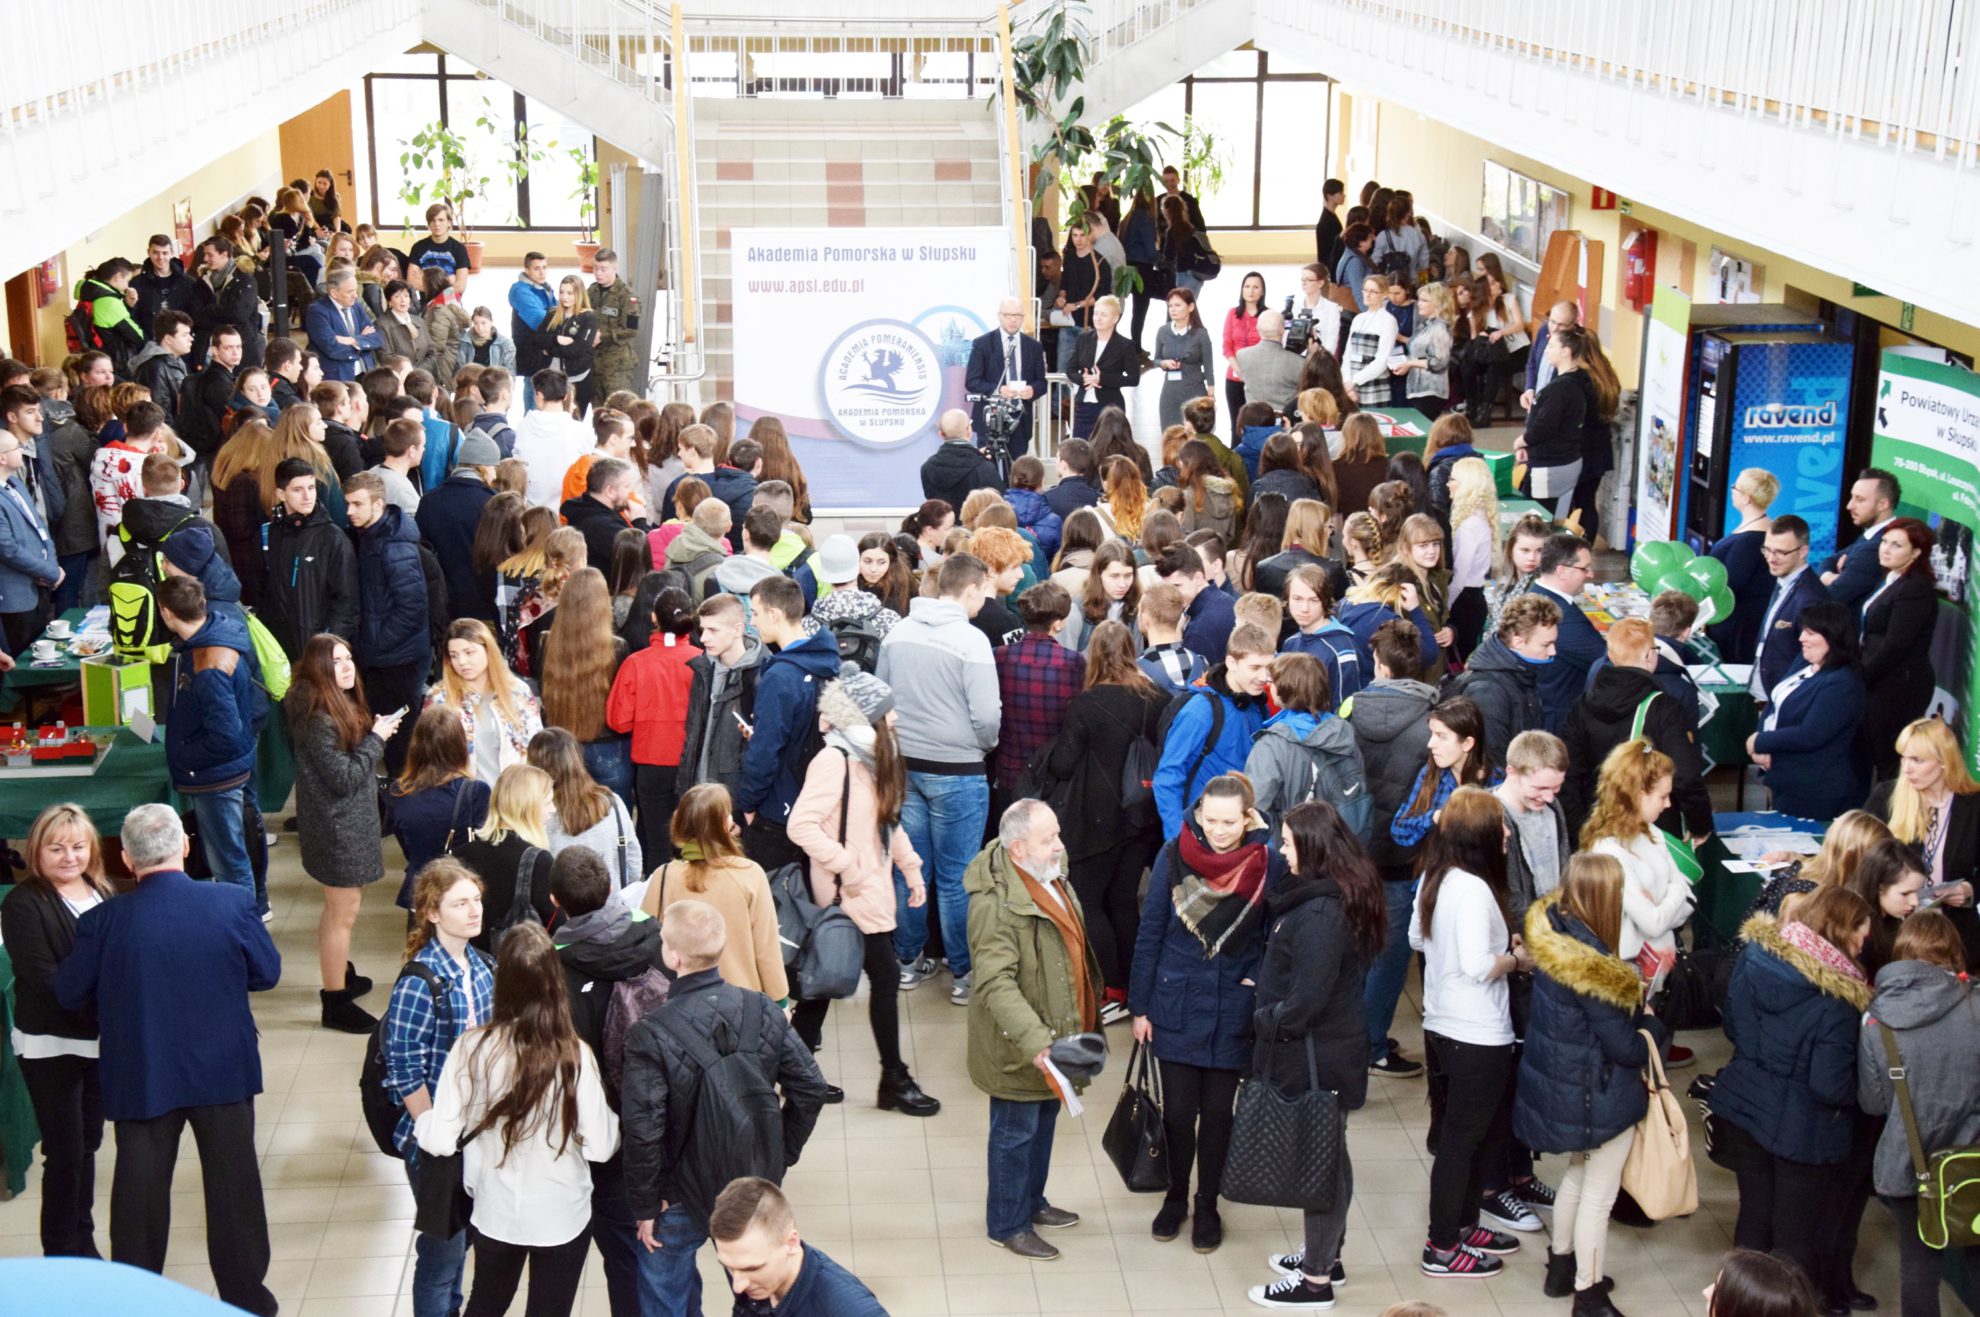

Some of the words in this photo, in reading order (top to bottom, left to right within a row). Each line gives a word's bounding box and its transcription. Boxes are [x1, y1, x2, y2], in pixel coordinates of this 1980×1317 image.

[748, 247, 818, 262] Akademia
[824, 247, 897, 262] Pomorska
[902, 248, 914, 261] w
[919, 246, 977, 262] Słupsku
[748, 279, 865, 293] www.apsl.edu.pl
[838, 338, 869, 380] ACADEMIA
[871, 334, 927, 380] POMERANIENSIS
[838, 408, 879, 417] AKADEMIA
[881, 407, 926, 416] POMORSKA
[1746, 400, 1836, 427] ravend
[1901, 390, 1960, 423] Powiatowy
[1744, 431, 1835, 446] www.ravend.pl
